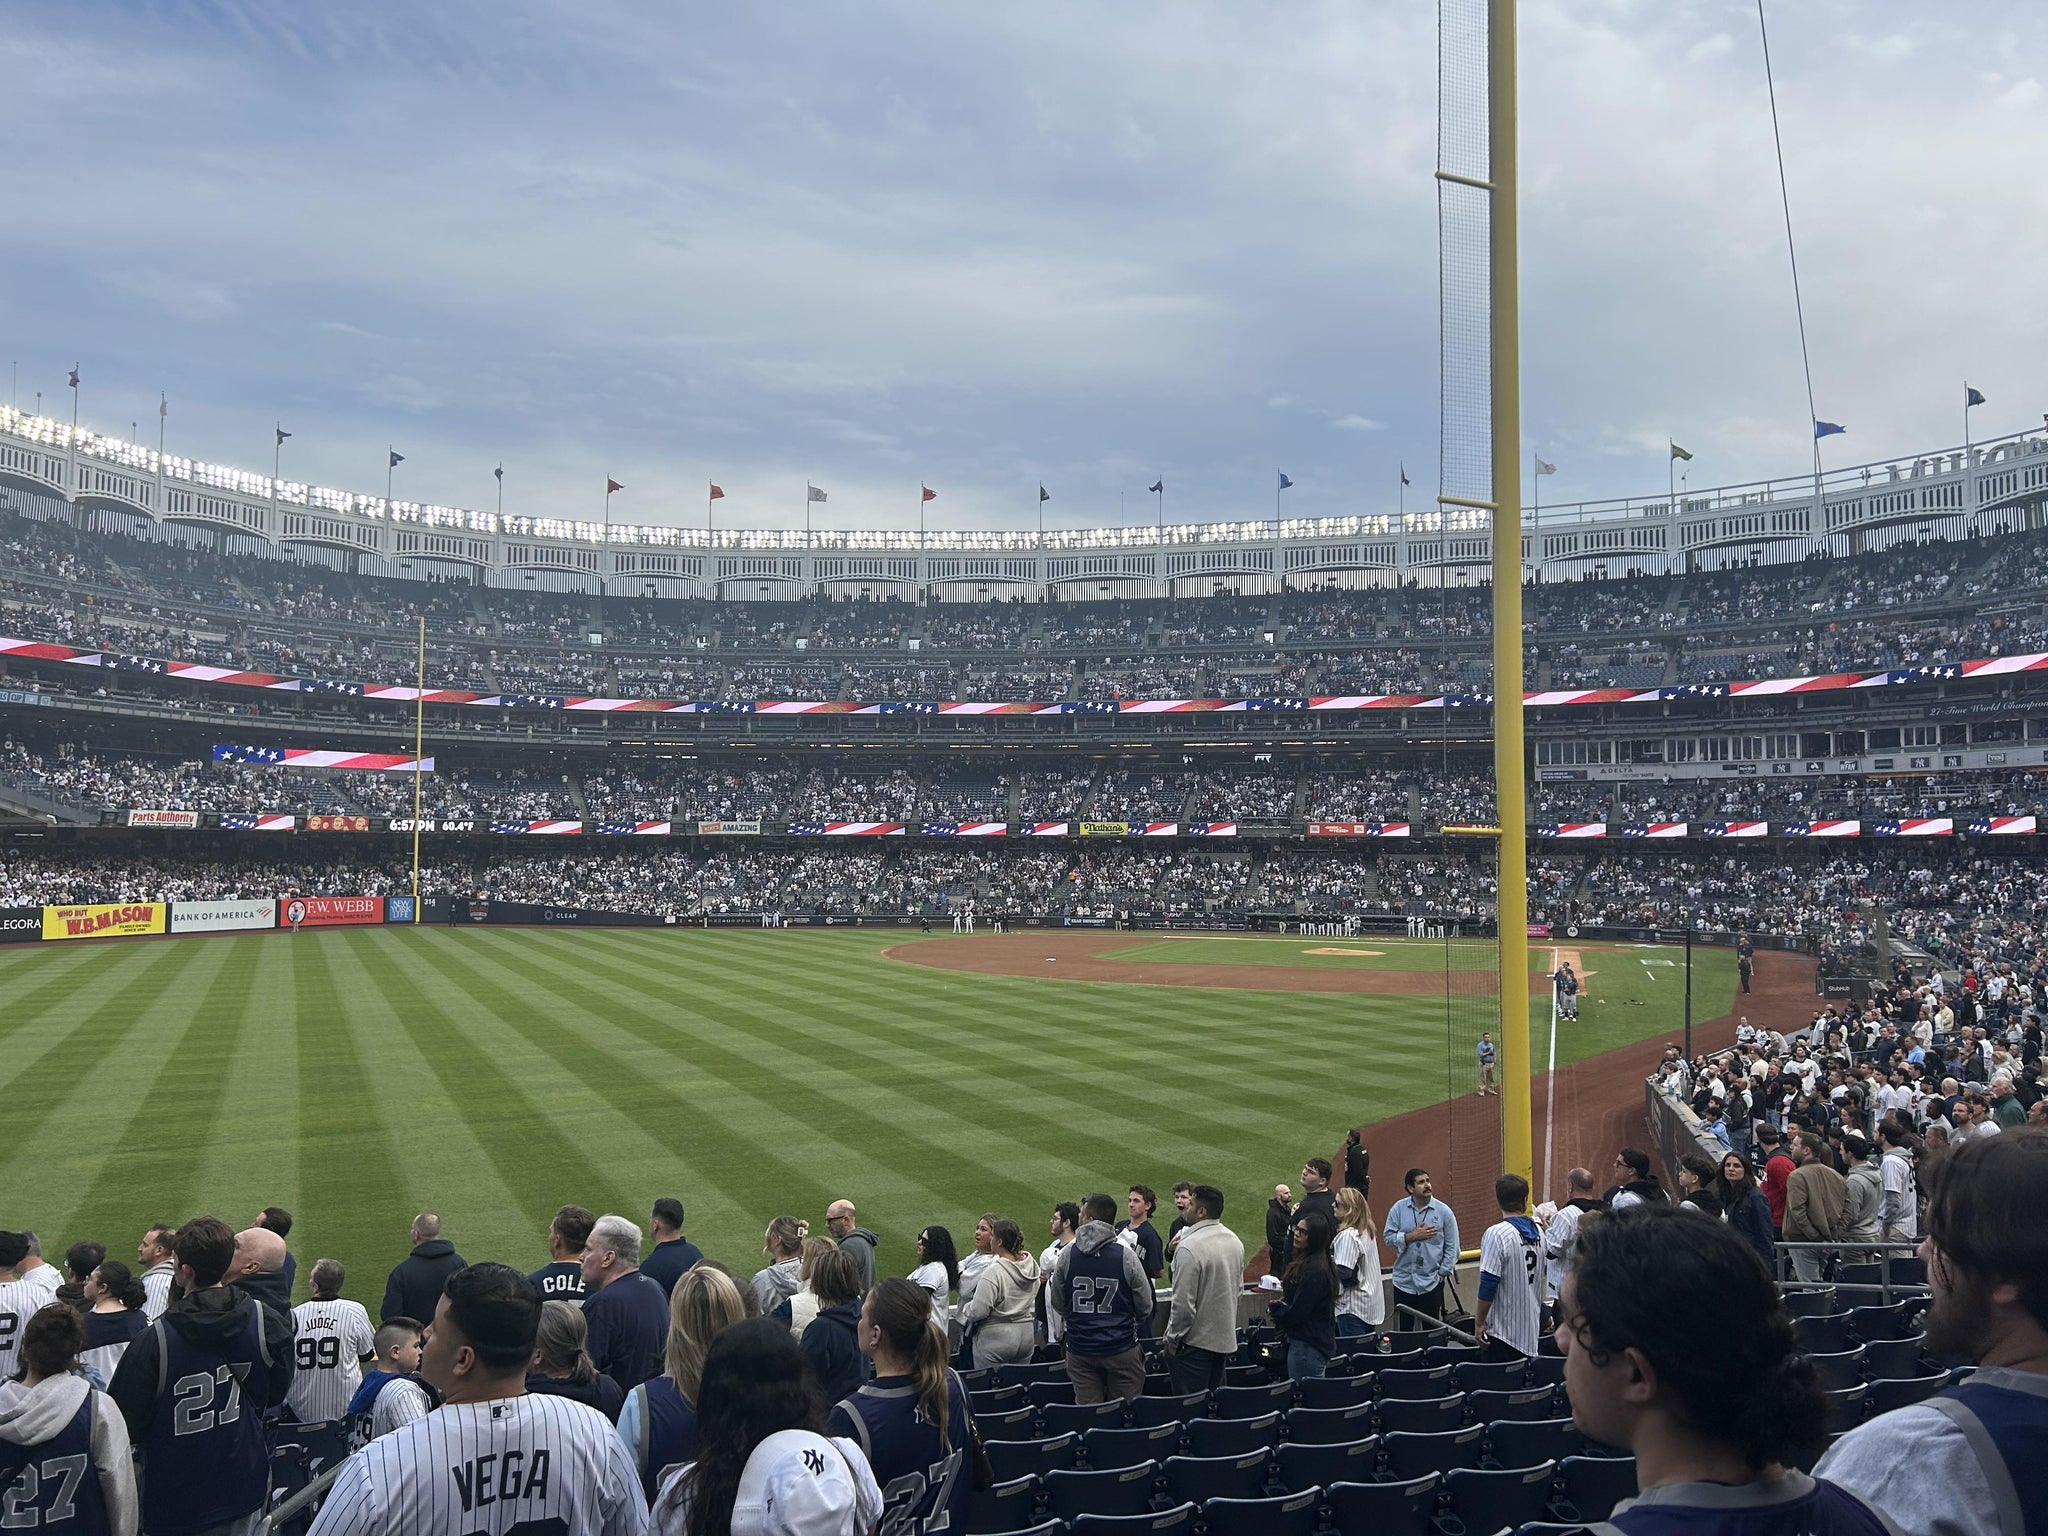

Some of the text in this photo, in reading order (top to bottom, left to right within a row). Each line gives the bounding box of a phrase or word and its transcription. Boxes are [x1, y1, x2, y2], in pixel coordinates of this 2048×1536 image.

[1970, 702, 2001, 713] World
[132, 811, 194, 822] Parts Authority
[390, 820, 416, 831] 6:57
[418, 820, 434, 832] PM
[1084, 823, 1123, 833] Nathan's
[57, 909, 88, 918] WHO BUT
[307, 900, 374, 913] F.W. WEBB
[391, 905, 412, 913] YORK
[174, 911, 255, 922] BANK OF AMERICA
[542, 1274, 586, 1294] COLE
[1072, 1275, 1119, 1314] 27
[305, 1317, 338, 1332] JUDGE
[296, 1336, 340, 1371] 99
[173, 1361, 252, 1437] 27
[803, 1449, 825, 1476] NY
[452, 1449, 550, 1513] VEGA
[1, 1453, 88, 1529] 27
[882, 1448, 963, 1536] 27
